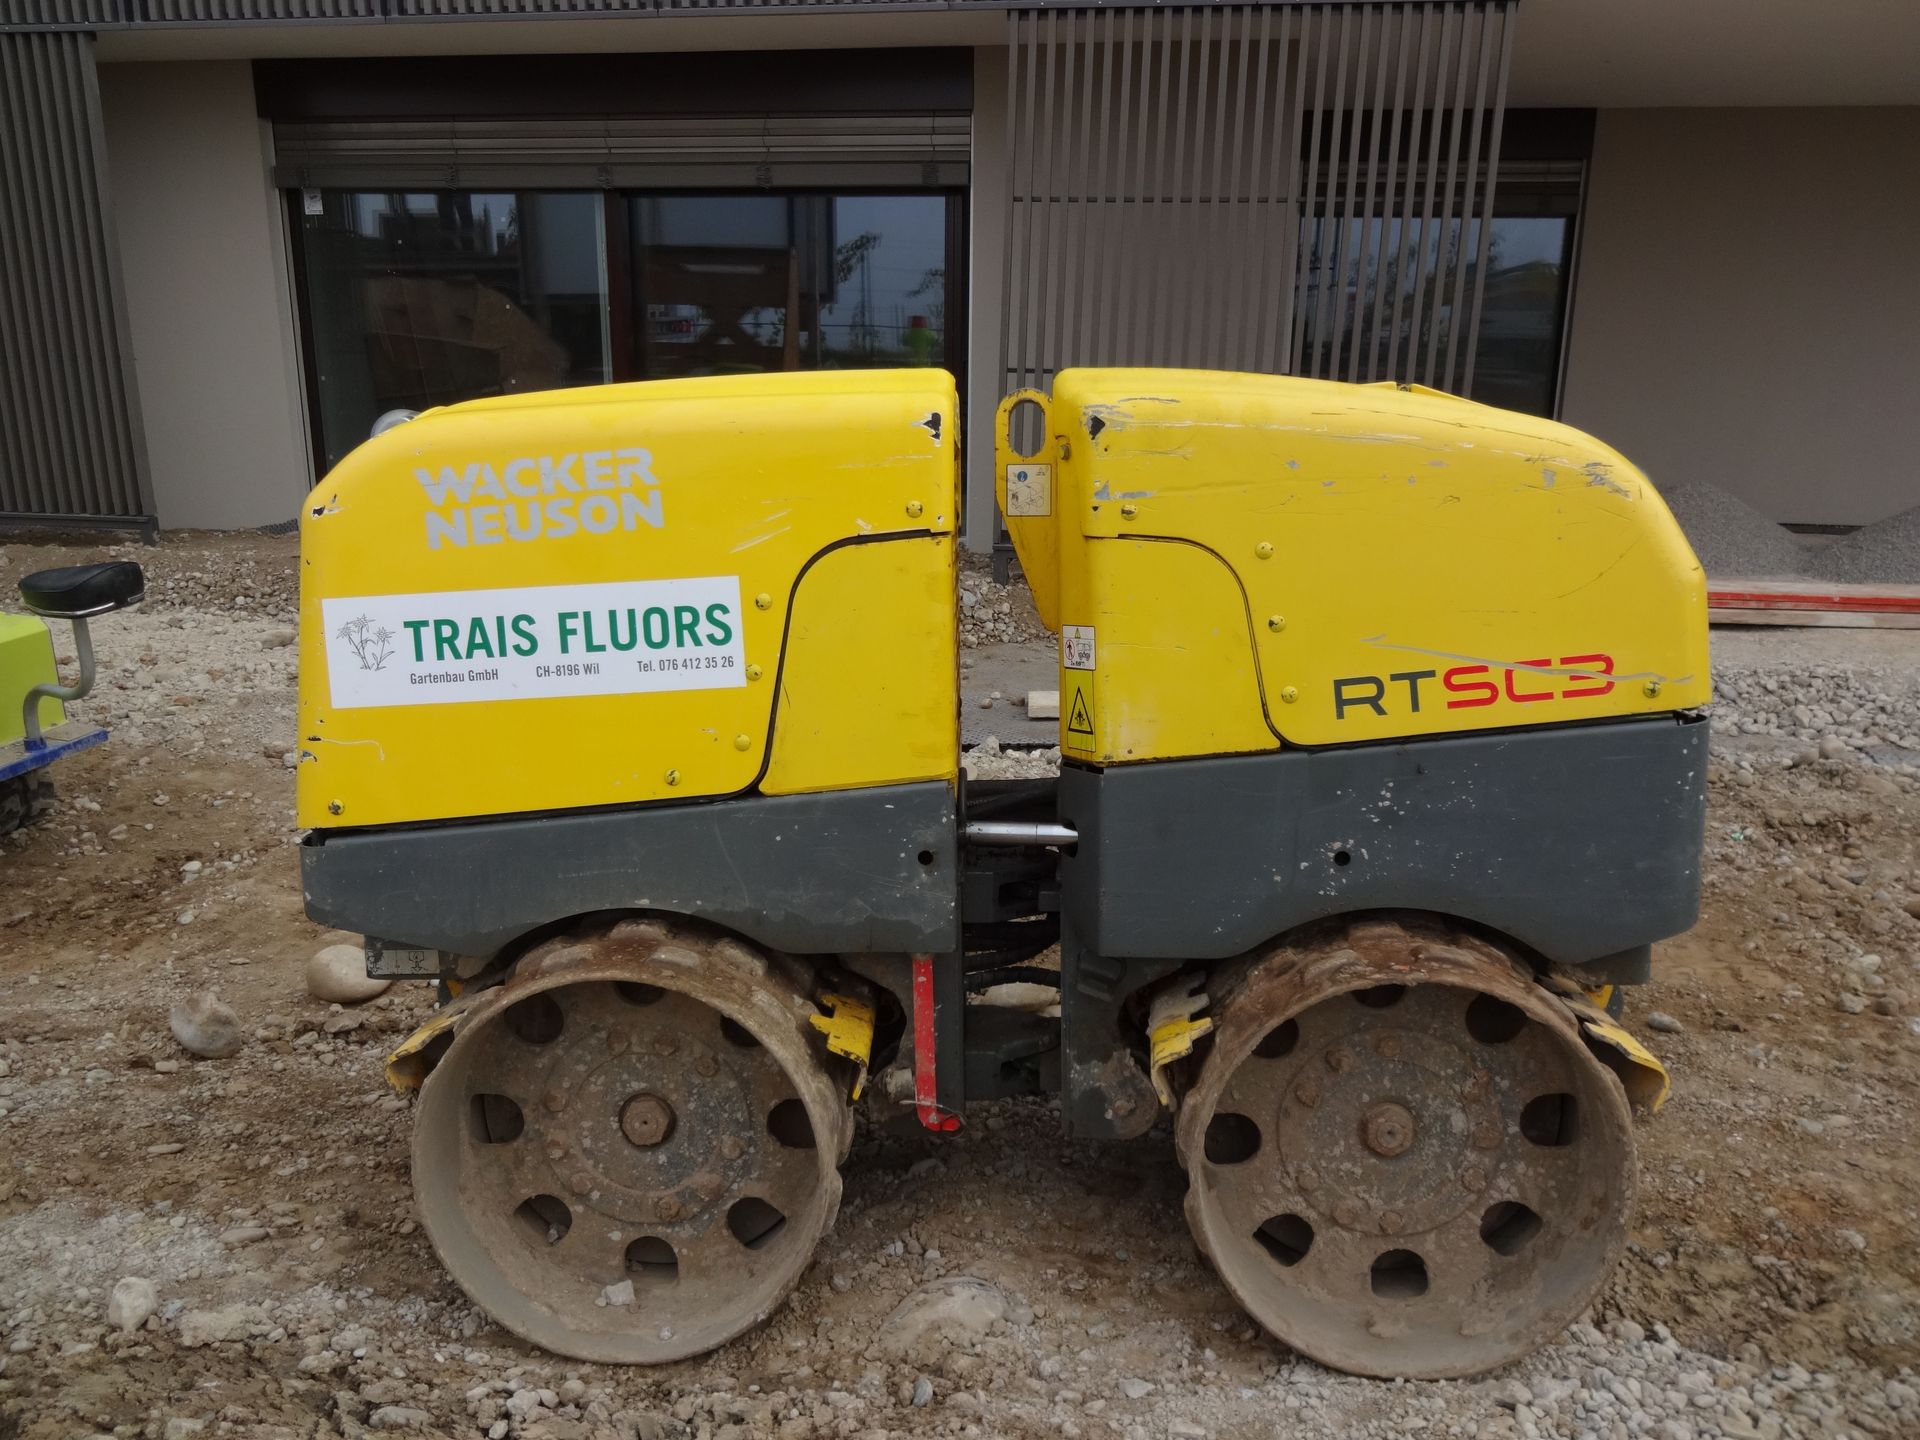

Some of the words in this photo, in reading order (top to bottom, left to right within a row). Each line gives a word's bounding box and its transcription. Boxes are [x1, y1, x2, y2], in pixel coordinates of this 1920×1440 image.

[414, 447, 659, 505] WACKER
[423, 490, 664, 550] NEUSON
[403, 614, 539, 662] TRAIS
[557, 603, 733, 654] FLUORS
[410, 671, 465, 685] Gartenbau
[468, 668, 499, 682] GmbH
[536, 663, 580, 678] CH-8196
[583, 663, 600, 676] Wil
[637, 660, 656, 673] Tel.
[658, 659, 679, 672] 076
[681, 657, 702, 670] 412
[704, 656, 718, 669] 35
[721, 655, 734, 668] 26
